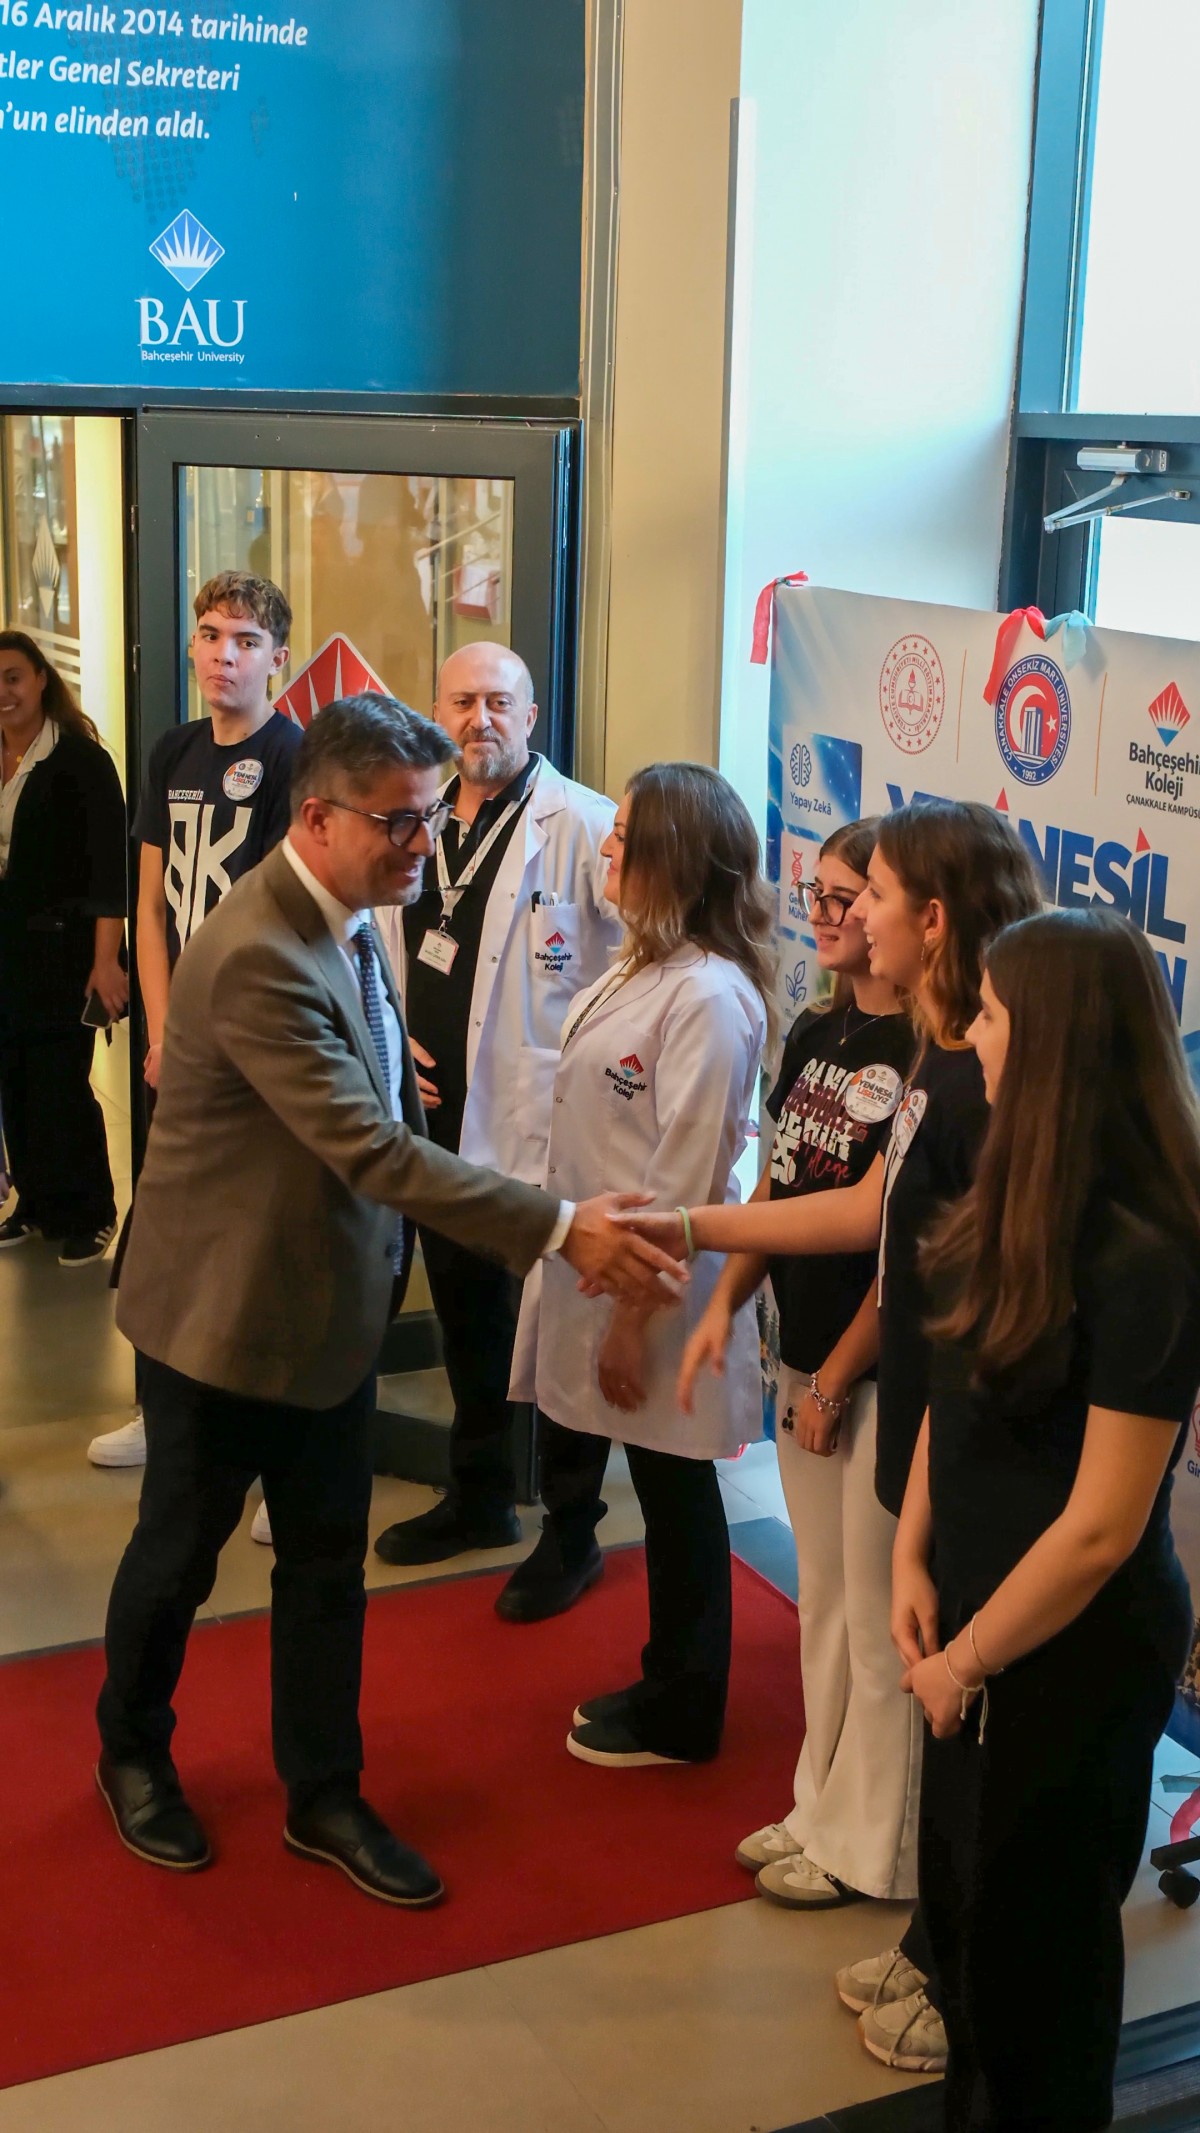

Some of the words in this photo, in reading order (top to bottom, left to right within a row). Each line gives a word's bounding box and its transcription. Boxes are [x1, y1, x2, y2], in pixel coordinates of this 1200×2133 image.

[0, 0, 28, 27] 16
[33, 2, 116, 34] Aralık
[120, 8, 184, 37] 2014
[190, 13, 308, 46] tarihinde
[49, 55, 121, 85] Genel
[126, 59, 241, 91] Sekreteri
[54, 106, 149, 137] elinden
[155, 110, 210, 139] aldı.
[134, 297, 248, 347] BAU
[141, 350, 193, 363] Bahçeşehir
[197, 351, 245, 365] University
[997, 687, 1013, 761] ÇANAKKALE
[1007, 659, 1040, 688] ONSEKİZ
[1039, 661, 1060, 686] MART
[1051, 684, 1069, 769] ÜNİVERSİTESİ
[1021, 769, 1037, 781] 1992
[1145, 770, 1184, 801] Koleji
[790, 791, 813, 813] Yapay
[813, 798, 832, 816] Zekâ
[1126, 793, 1167, 812] ÇANAKKALE
[1018, 818, 1187, 945] NESİL
[534, 952, 573, 963] Bahçeşehir
[544, 962, 564, 973] Koleji
[604, 1067, 648, 1092] Bahçeşehir
[613, 1083, 635, 1101] Koleji
